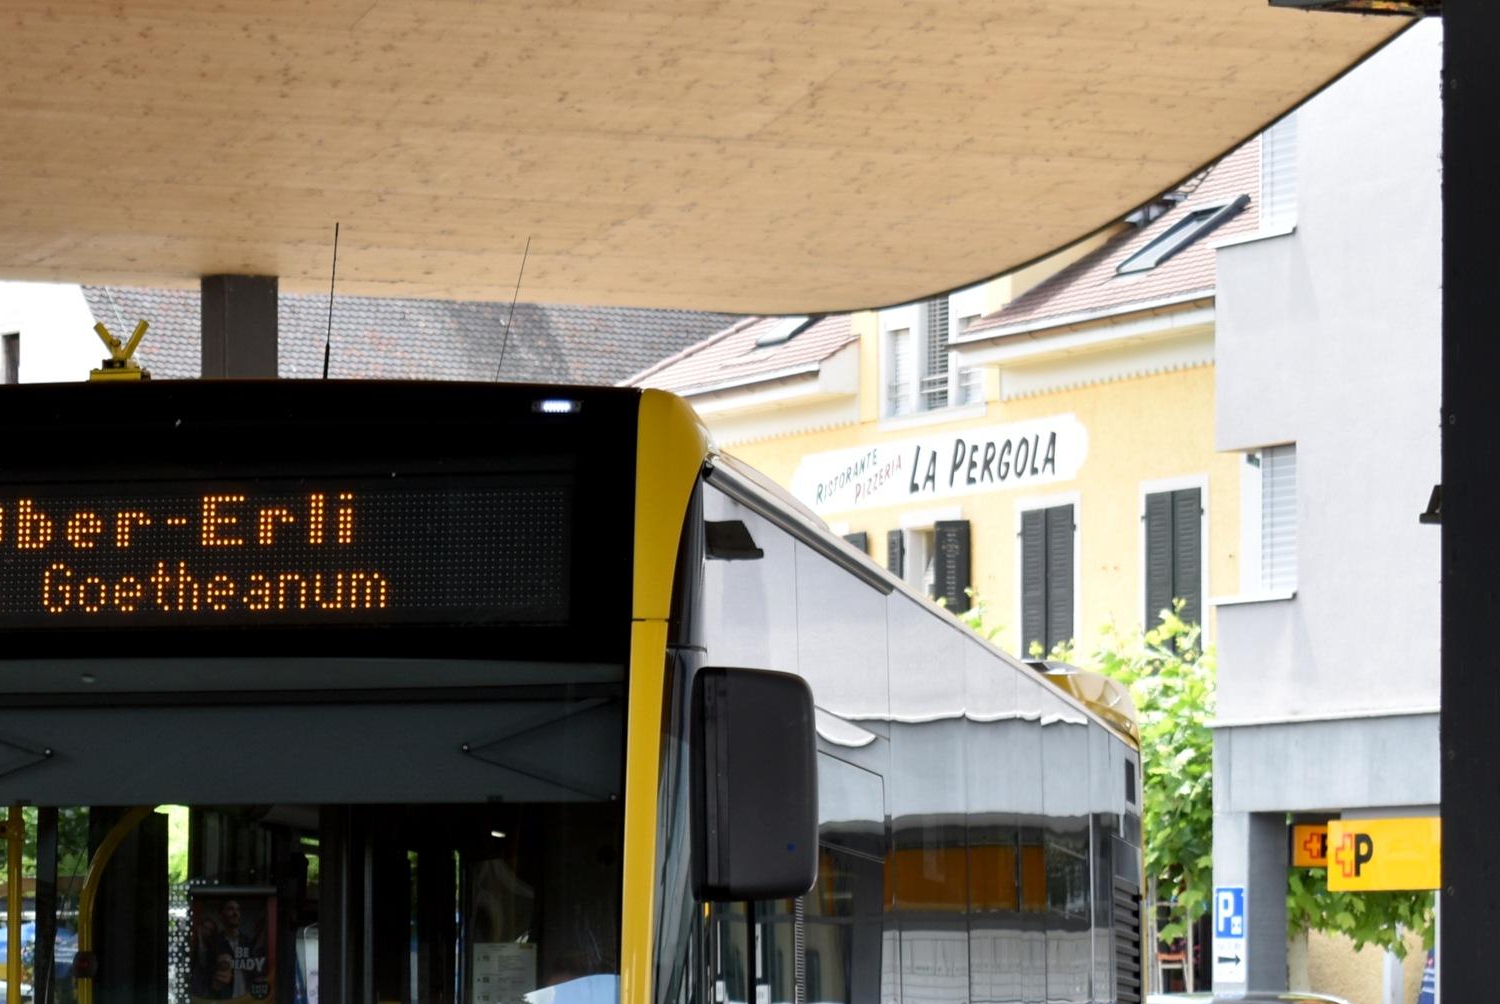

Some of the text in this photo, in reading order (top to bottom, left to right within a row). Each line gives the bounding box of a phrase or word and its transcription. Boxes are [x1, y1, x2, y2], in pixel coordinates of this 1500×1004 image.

[815, 447, 879, 505] RISTORANTE
[854, 454, 902, 504] PIZZERIA
[909, 431, 1058, 495] LA PERGOLA
[41, 561, 390, 614] Goetheanum
[1218, 891, 1235, 932] P
[234, 946, 250, 959] BE
